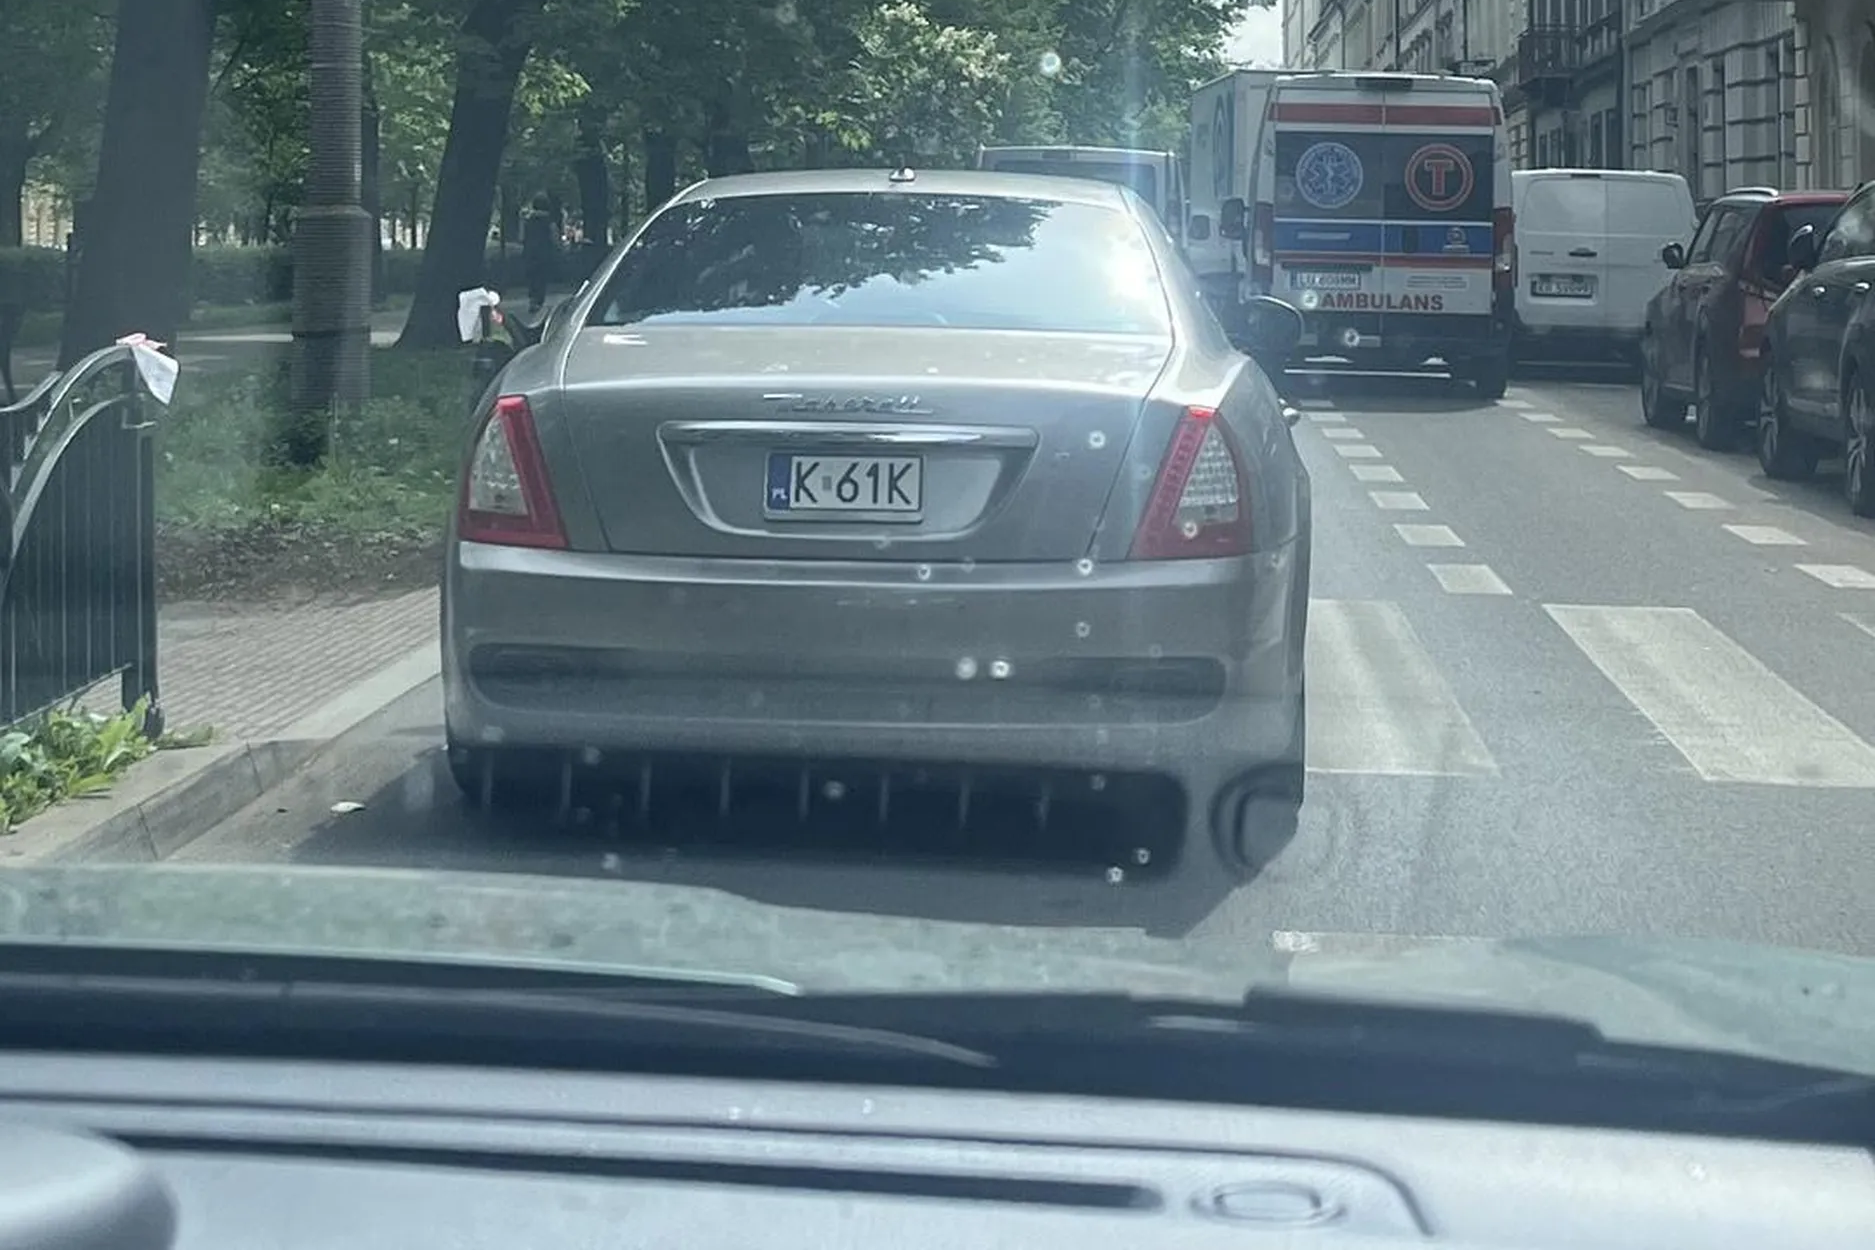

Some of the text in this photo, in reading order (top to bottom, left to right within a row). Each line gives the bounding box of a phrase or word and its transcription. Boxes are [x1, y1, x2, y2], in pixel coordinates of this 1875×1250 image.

[1424, 159, 1454, 195] T
[1321, 292, 1444, 311] AMBULANS
[772, 488, 788, 500] PL
